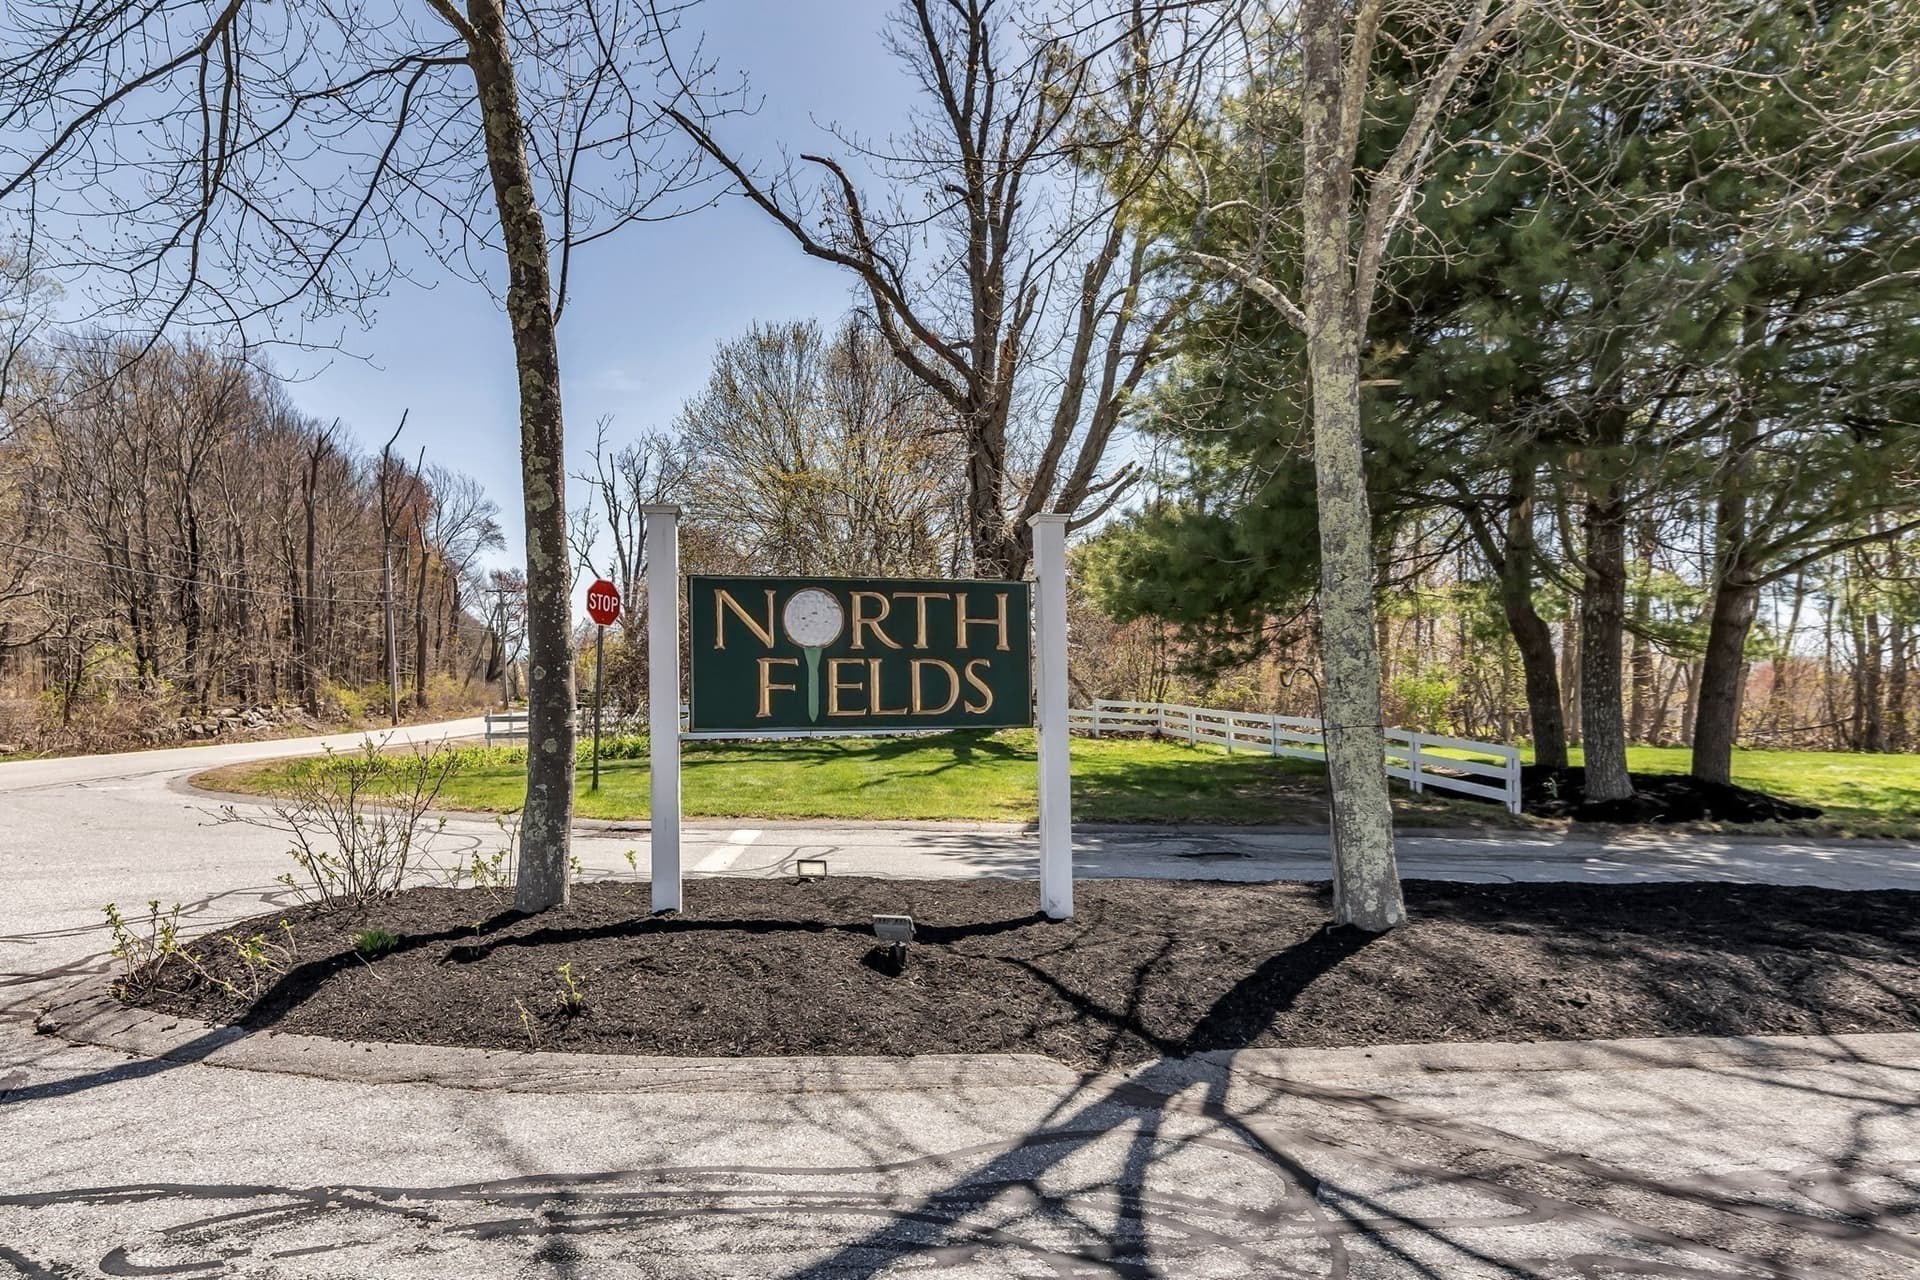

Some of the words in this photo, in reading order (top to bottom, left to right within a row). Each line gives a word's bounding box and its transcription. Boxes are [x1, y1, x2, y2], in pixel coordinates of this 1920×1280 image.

[589, 592, 619, 613] STOP
[714, 588, 1010, 651] NORTH
[756, 657, 994, 721] FIELDS
